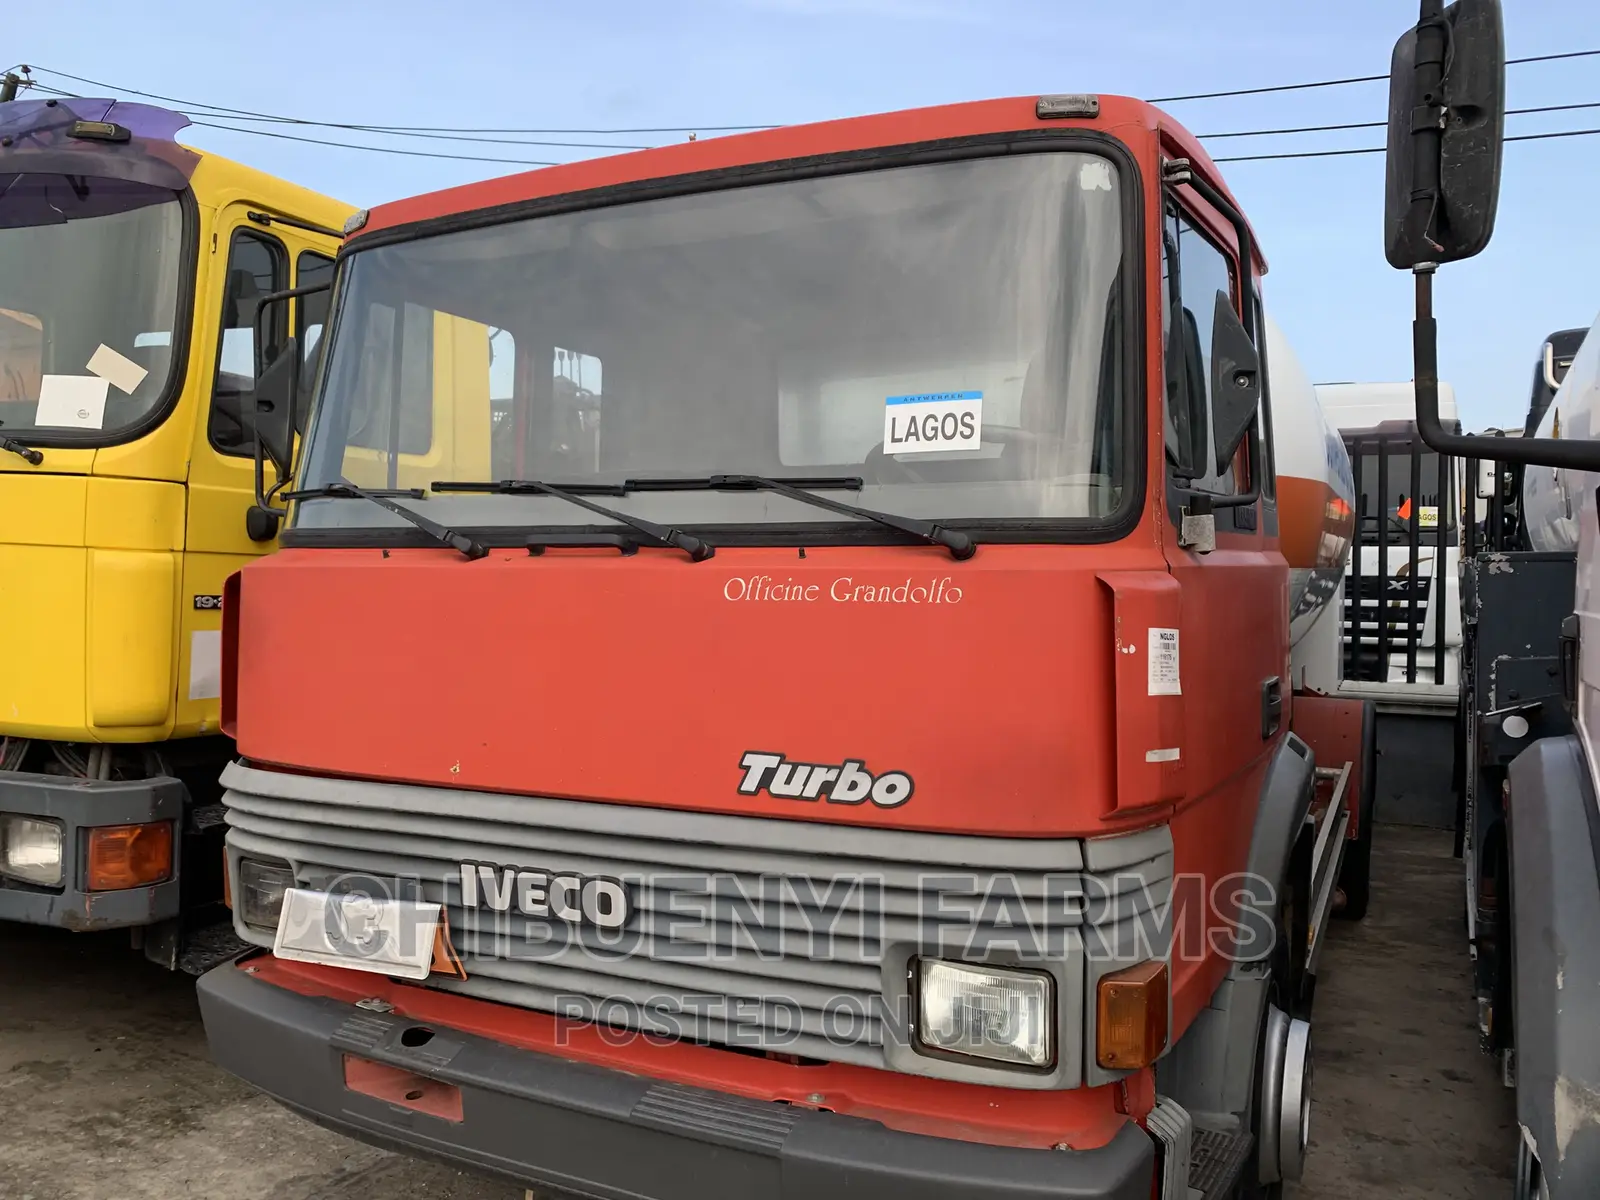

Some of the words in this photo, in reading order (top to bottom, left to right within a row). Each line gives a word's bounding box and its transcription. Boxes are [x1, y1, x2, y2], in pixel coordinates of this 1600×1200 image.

[903, 393, 964, 402] ANTWERPEN
[890, 411, 975, 443] LAGOS
[723, 575, 820, 602] Officine
[830, 576, 963, 604] Grandolfo
[738, 751, 914, 808] Turbo
[459, 860, 634, 930] IVECO
